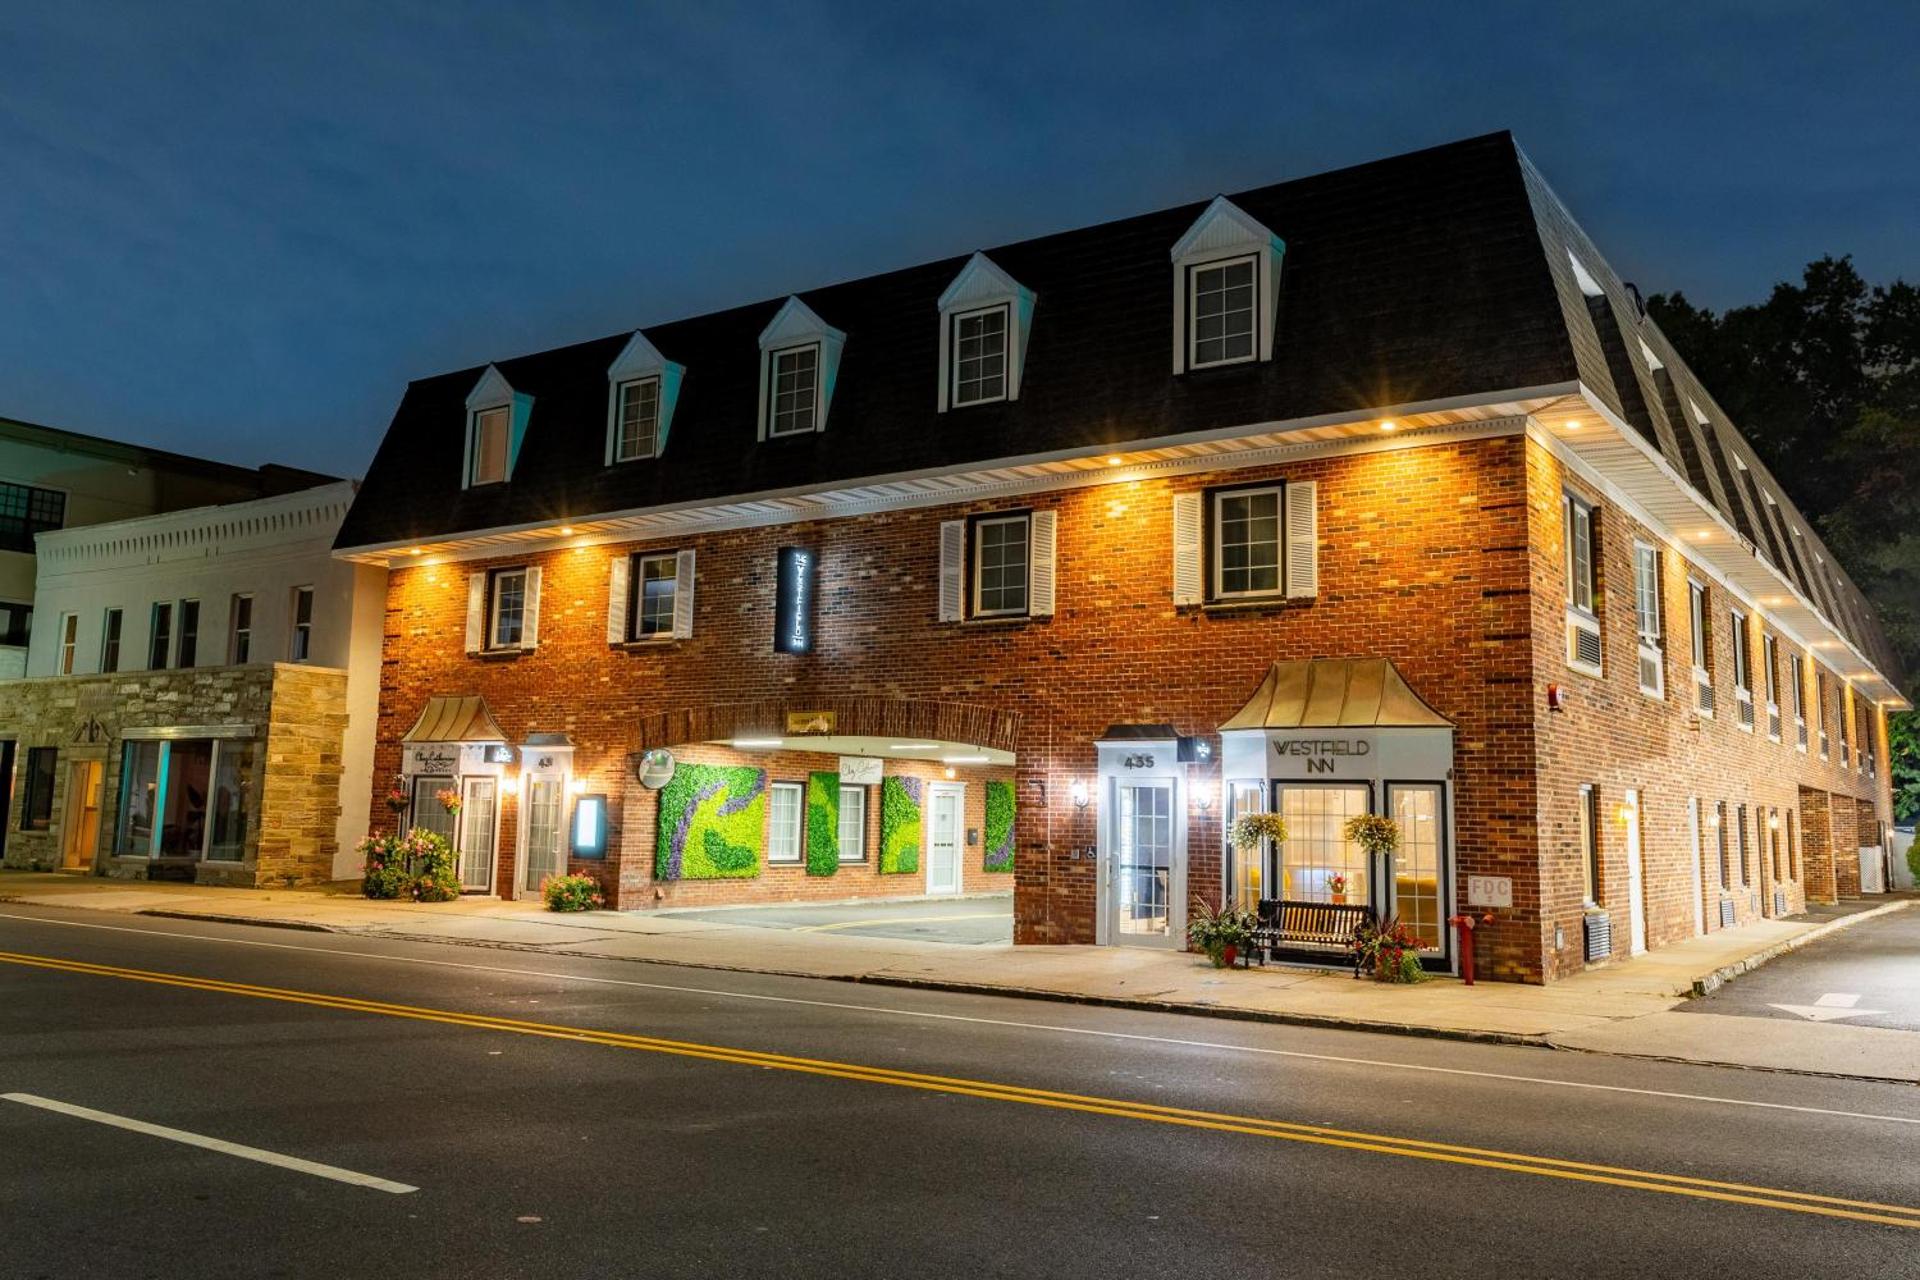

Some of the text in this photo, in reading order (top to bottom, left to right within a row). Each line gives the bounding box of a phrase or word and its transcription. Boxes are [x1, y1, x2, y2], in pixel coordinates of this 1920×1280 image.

[1273, 740, 1370, 756] WESTFIELD
[1124, 755, 1155, 770] 435
[1307, 758, 1335, 773] INN
[1472, 879, 1508, 896] FDC
